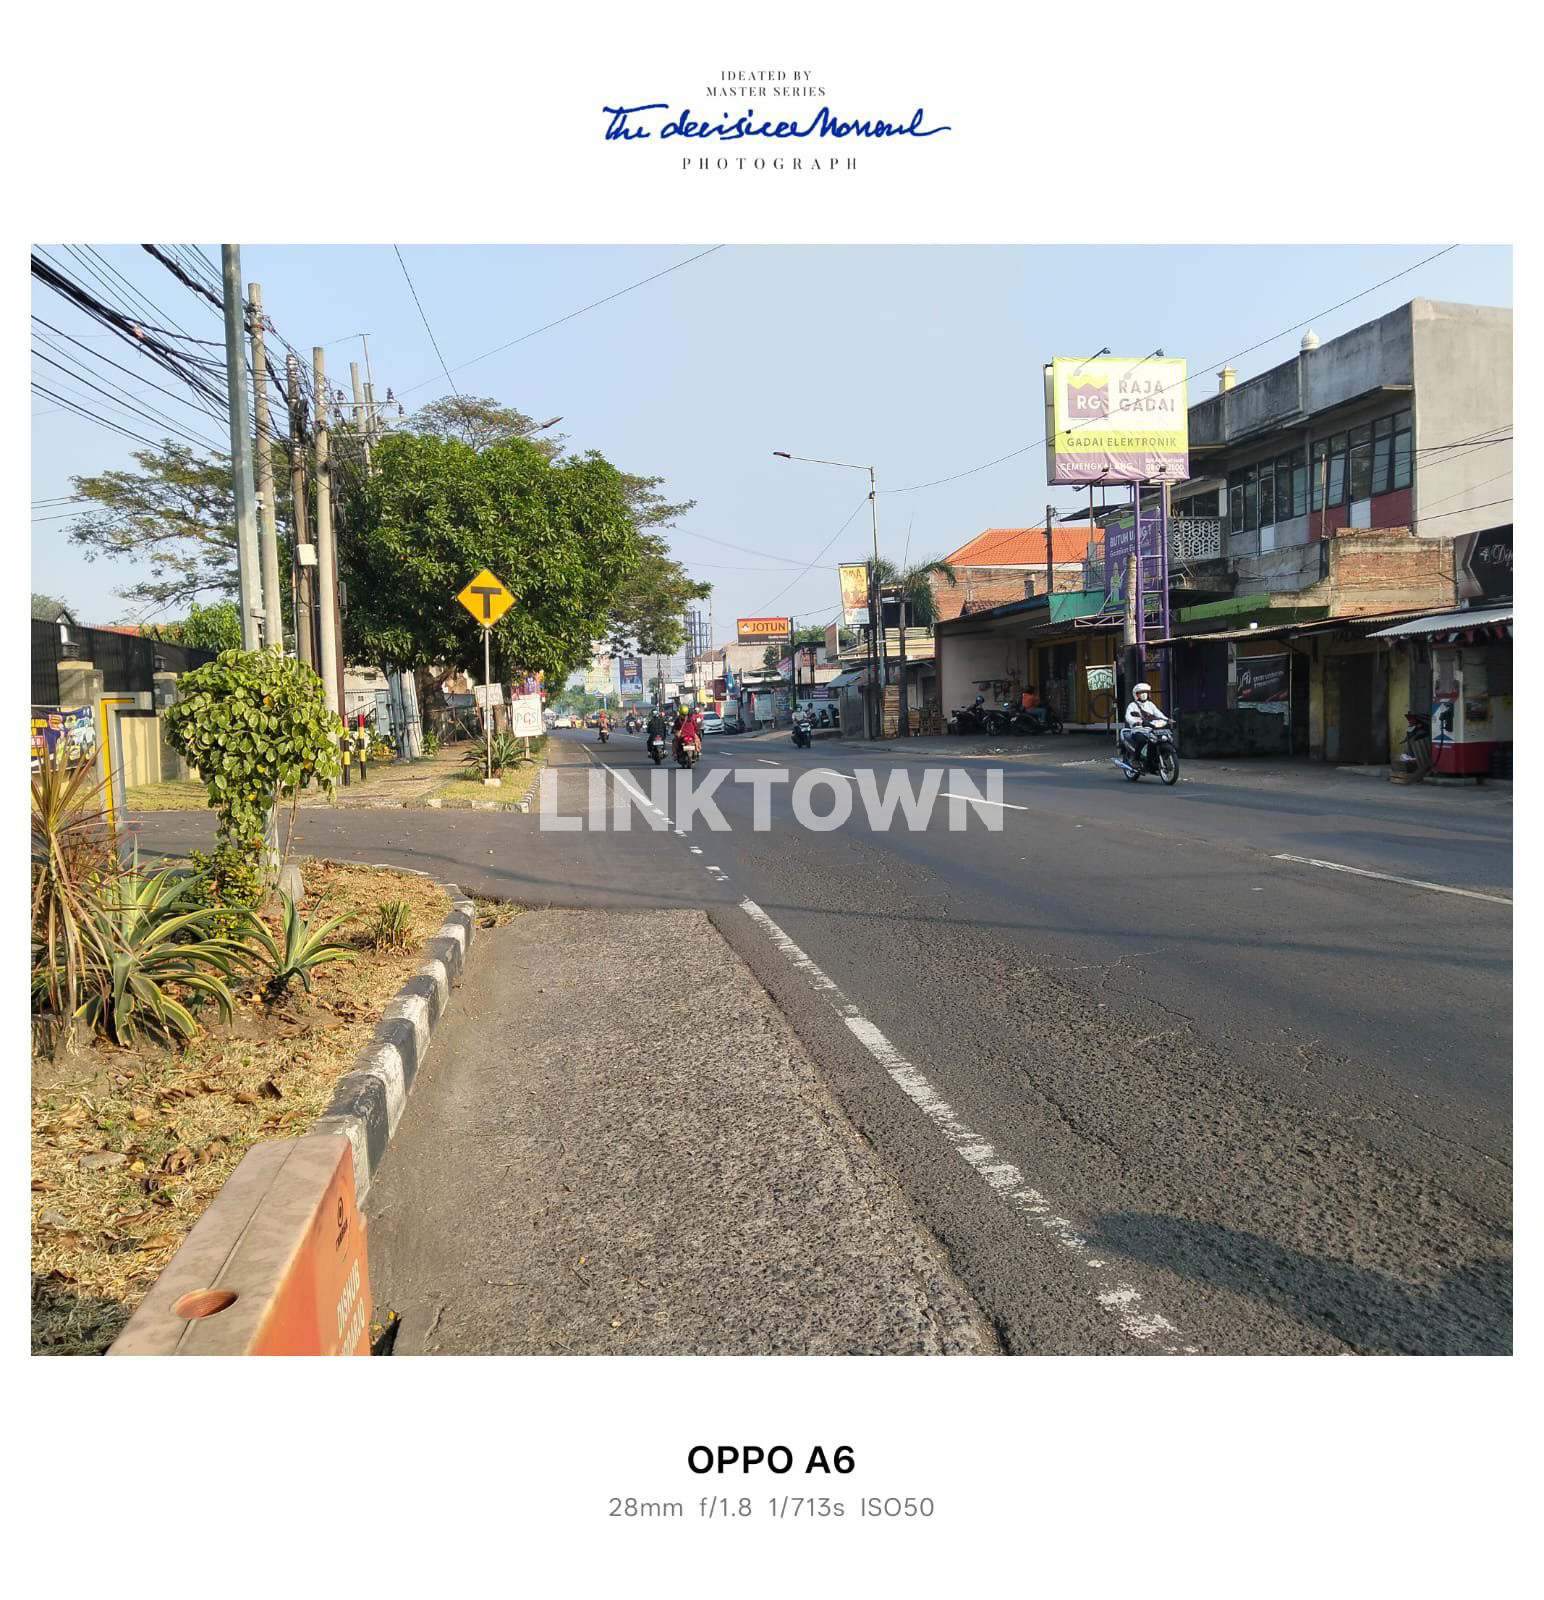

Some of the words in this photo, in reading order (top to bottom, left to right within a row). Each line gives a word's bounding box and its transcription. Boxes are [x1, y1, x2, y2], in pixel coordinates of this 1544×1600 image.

[1118, 379, 1164, 395] RAJA
[1076, 395, 1101, 410] RG
[1118, 397, 1175, 412] GADAI
[1066, 437, 1104, 448] GADAI
[1107, 437, 1177, 447] ELEKTRONIK
[1109, 531, 1129, 549] BUTUH
[752, 622, 786, 633] JOTUN
[515, 711, 537, 726] PGS
[337, 1258, 360, 1339] DISHUB
